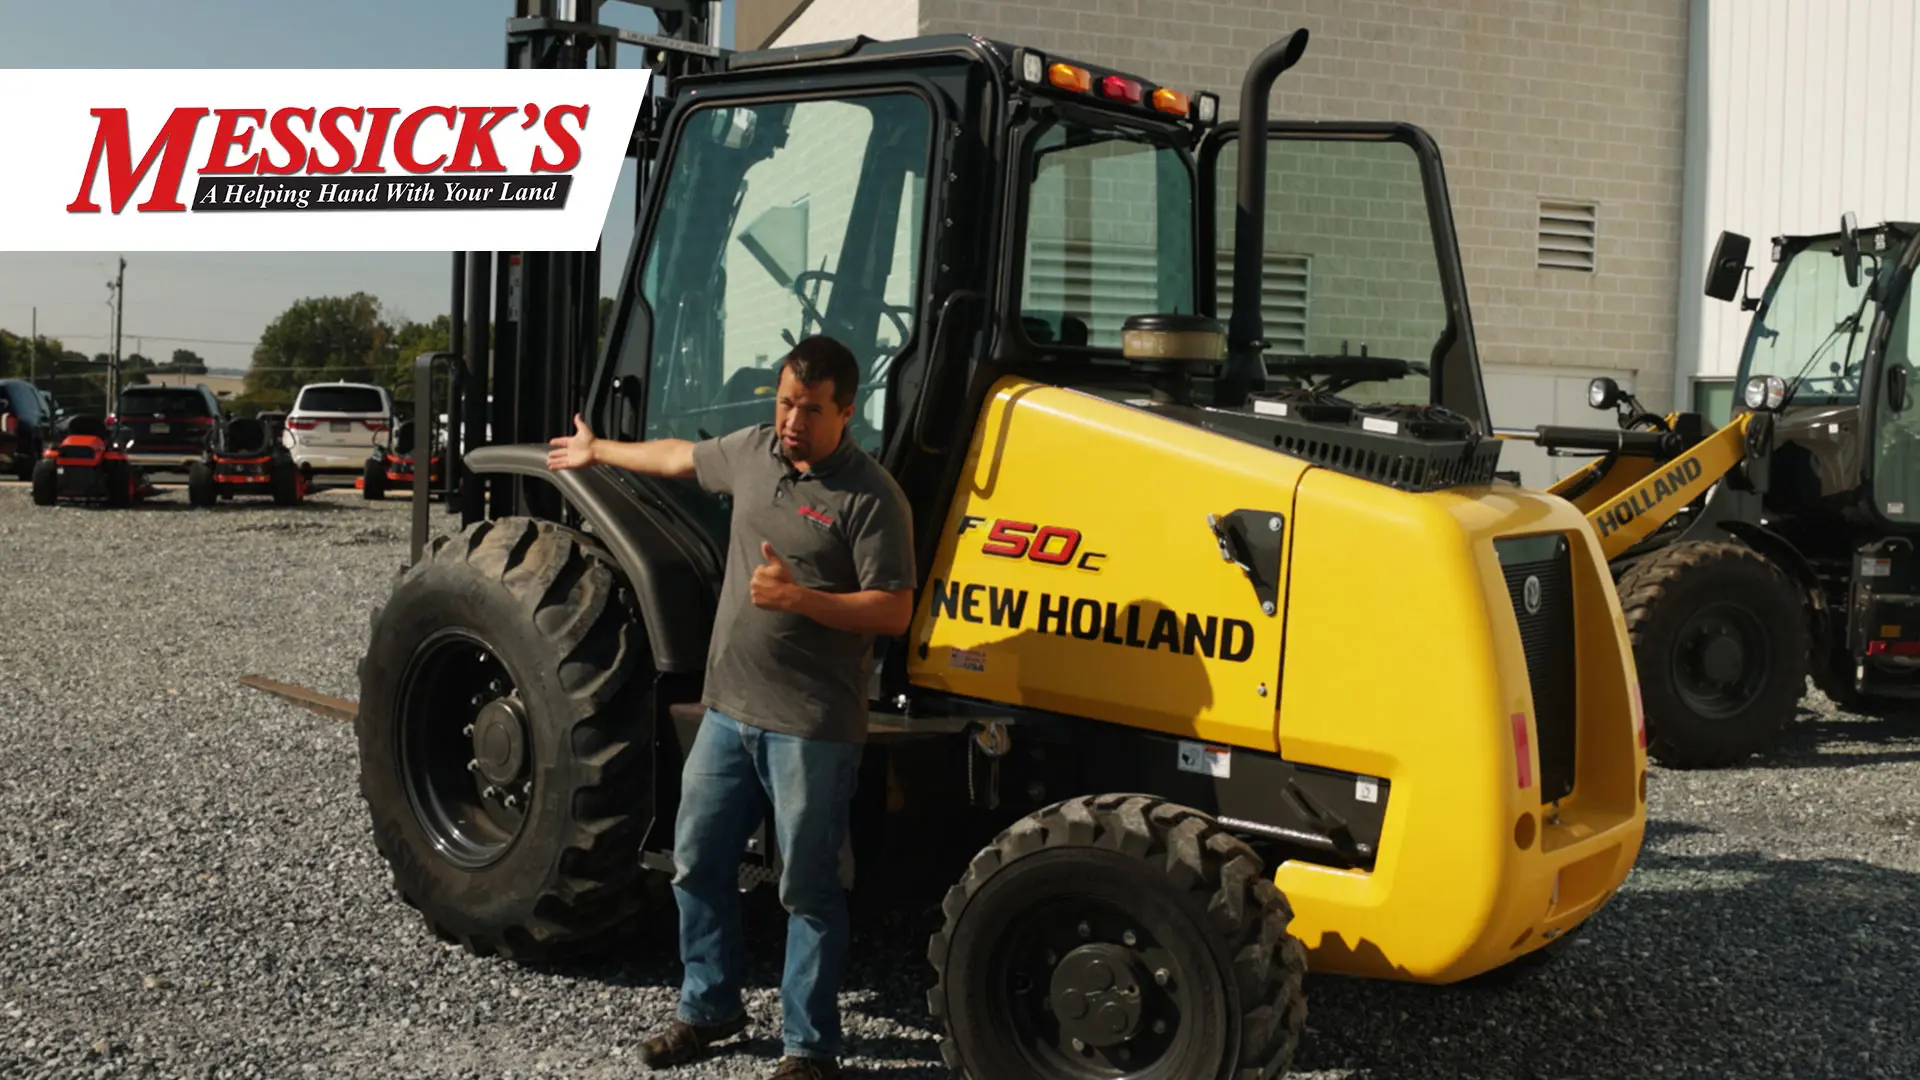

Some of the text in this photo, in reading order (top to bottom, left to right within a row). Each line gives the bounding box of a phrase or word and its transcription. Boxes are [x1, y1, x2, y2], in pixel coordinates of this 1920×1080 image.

[1596, 457, 1702, 537] HOLLAND
[931, 578, 1255, 663] NEW HOLLAND
